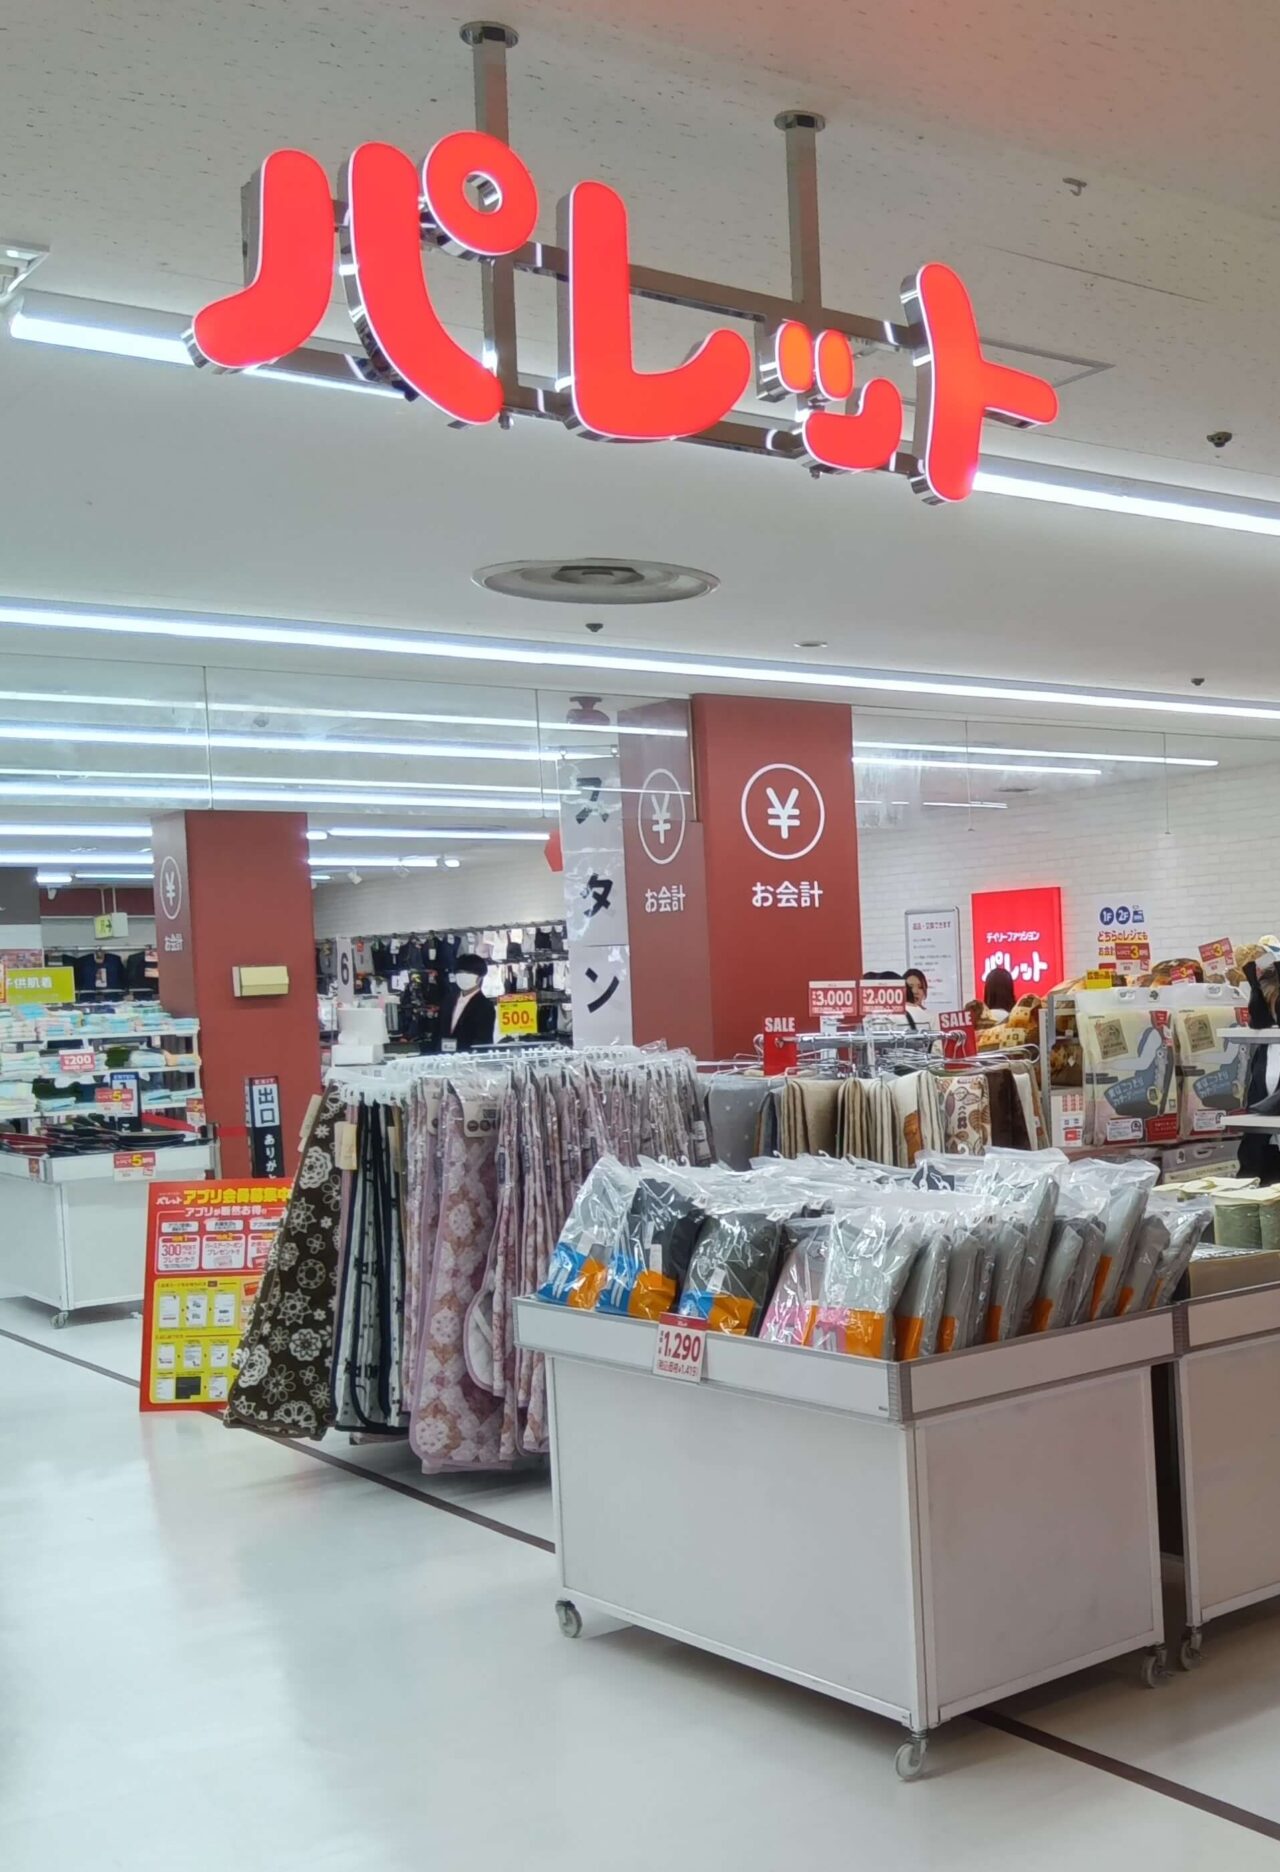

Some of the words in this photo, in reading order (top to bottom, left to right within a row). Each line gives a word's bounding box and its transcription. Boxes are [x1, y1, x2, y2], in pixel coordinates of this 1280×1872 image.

[191, 130, 1058, 503] パレット
[644, 884, 686, 912] お会計
[751, 880, 823, 908] お会計
[986, 931, 1040, 943] デイリーファッション
[982, 951, 1048, 983] パレット
[765, 1016, 796, 1032] SALE
[940, 1011, 973, 1029] SALE
[258, 1087, 275, 1124] 出口
[664, 1331, 701, 1362] 1,290
